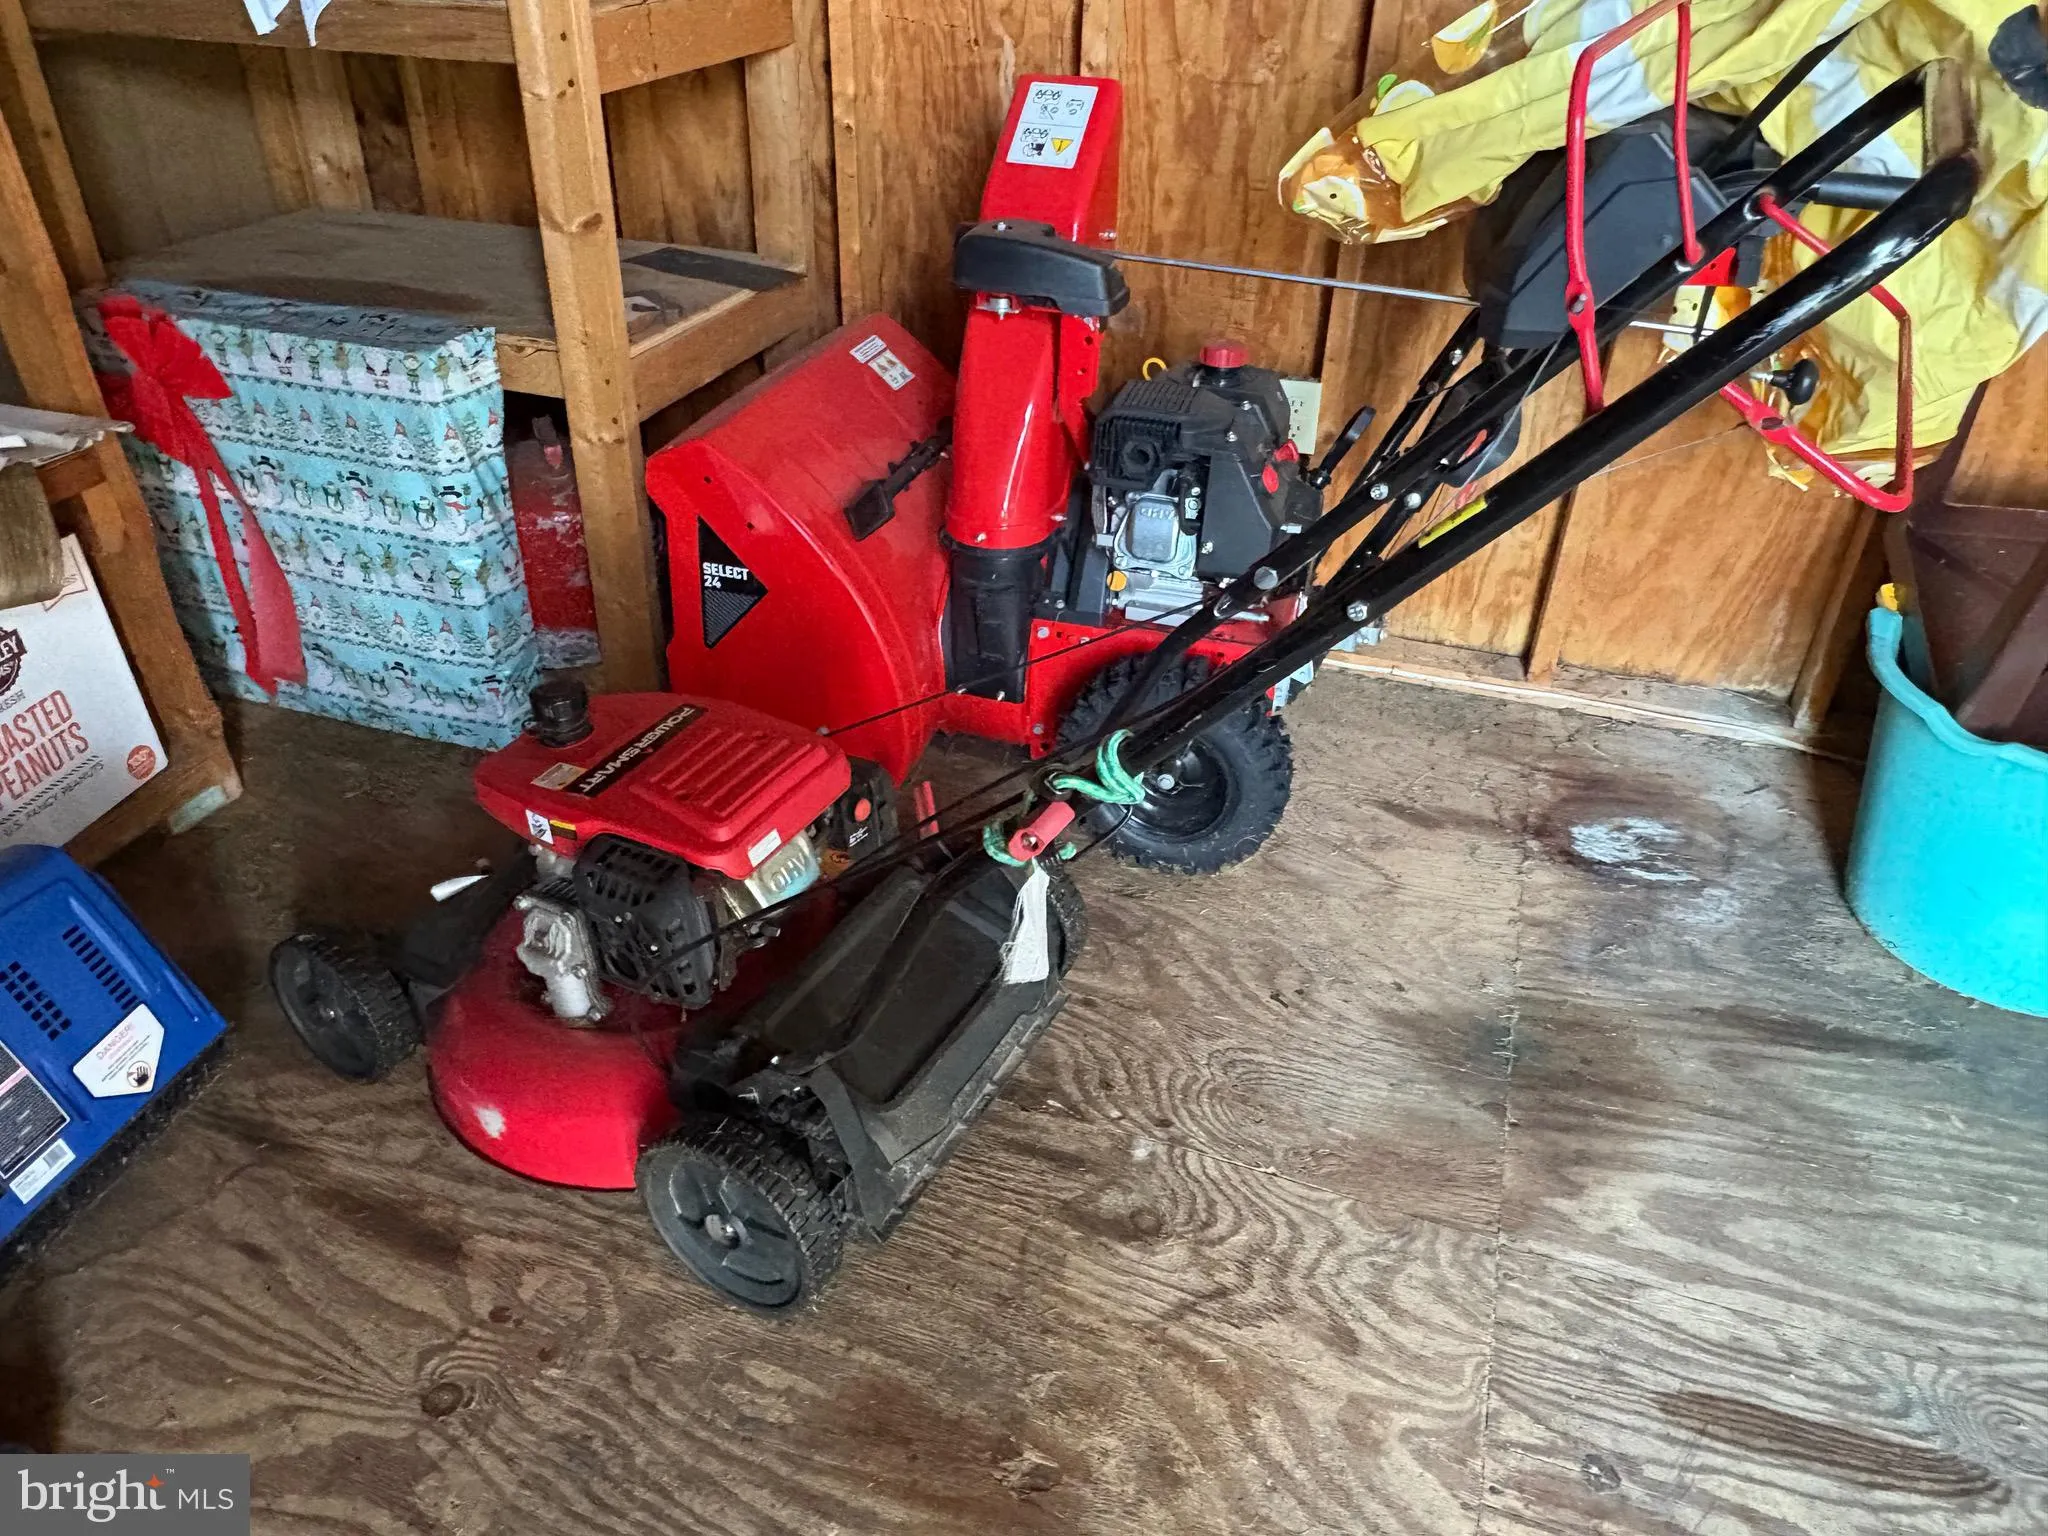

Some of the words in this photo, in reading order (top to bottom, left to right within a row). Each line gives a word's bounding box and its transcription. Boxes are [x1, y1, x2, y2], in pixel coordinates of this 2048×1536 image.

[703, 562, 749, 580] SELECT
[704, 575, 721, 588] 24
[0, 722, 89, 800] EANUTS
